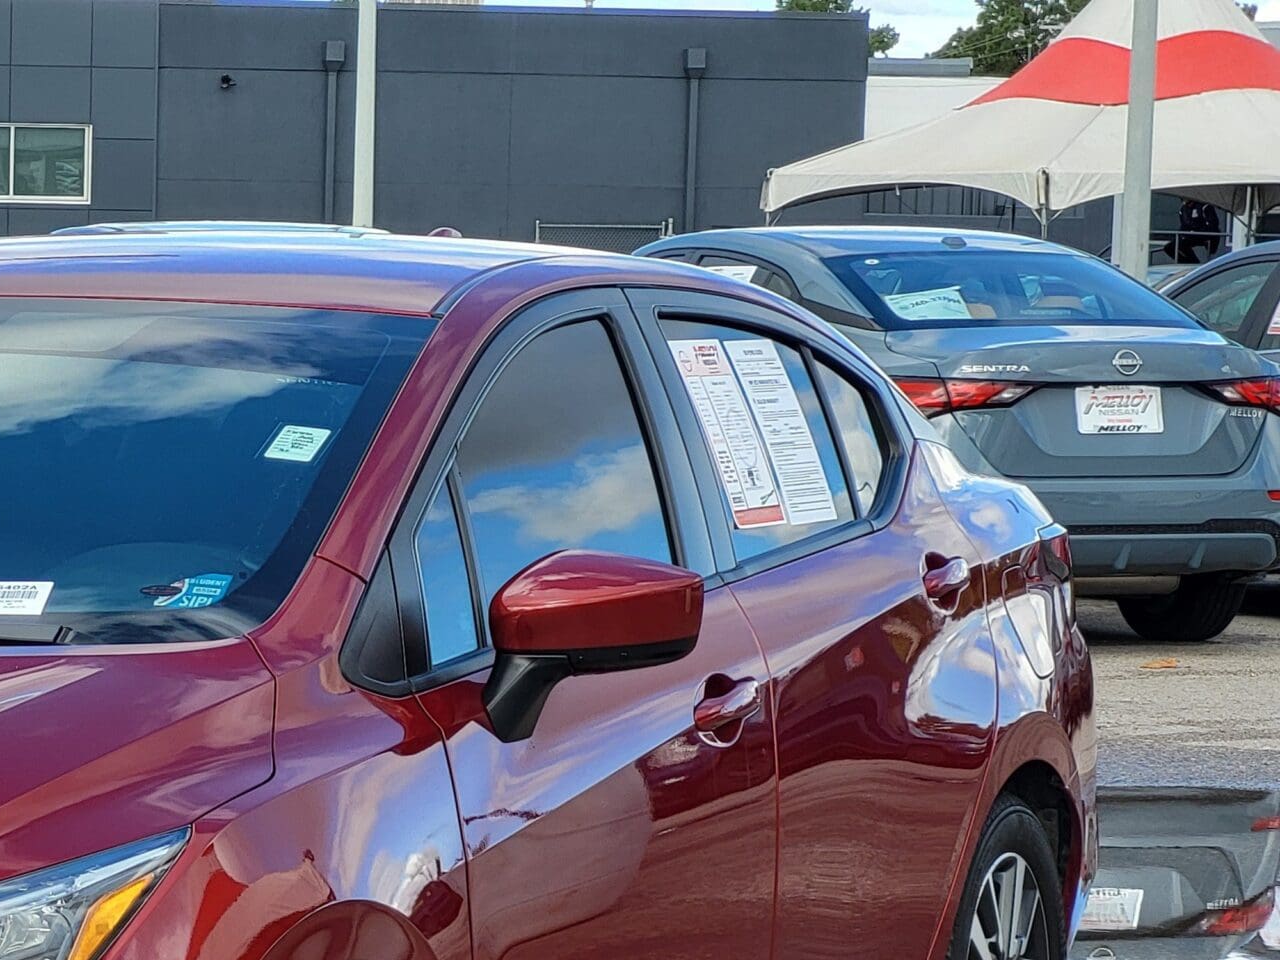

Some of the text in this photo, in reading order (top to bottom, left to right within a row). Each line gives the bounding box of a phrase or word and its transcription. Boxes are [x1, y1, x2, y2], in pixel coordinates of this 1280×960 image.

[960, 364, 1032, 373] SENTRA
[1083, 394, 1154, 415] MELLOY
[1097, 424, 1144, 433] MELLOY
